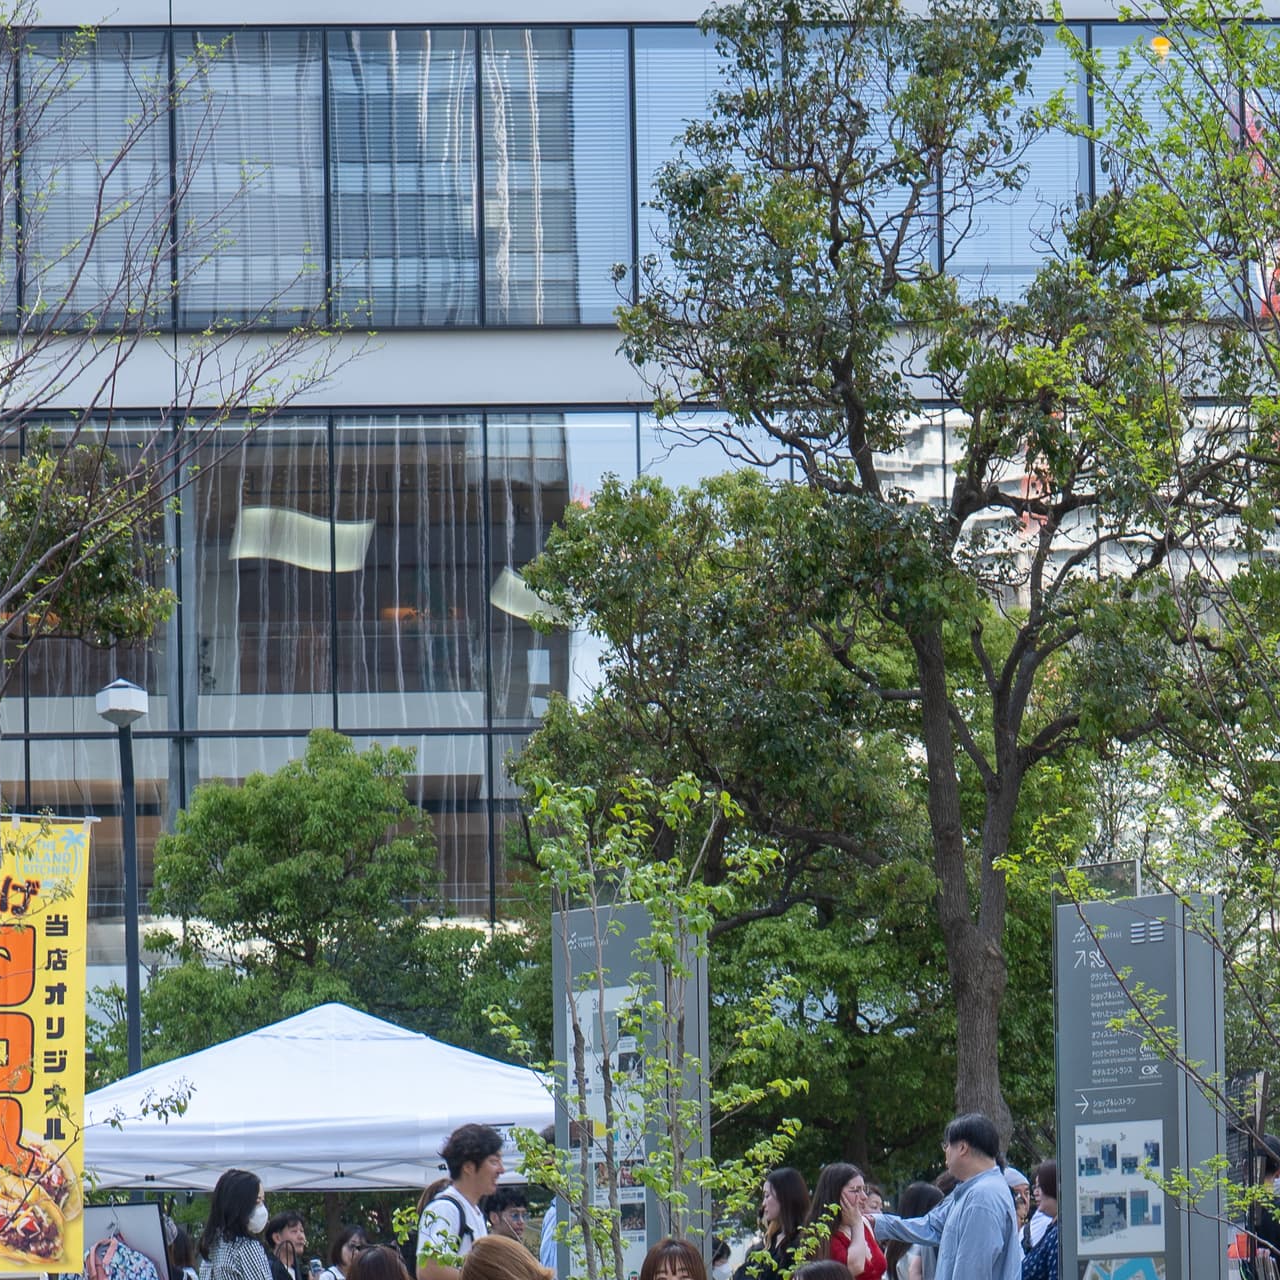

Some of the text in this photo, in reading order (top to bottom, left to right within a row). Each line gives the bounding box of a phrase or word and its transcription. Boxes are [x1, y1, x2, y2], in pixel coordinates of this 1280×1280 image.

[36, 840, 56, 851] THE
[23, 864, 71, 875] KITCHEN
[43, 914, 68, 1141] 当店オリジナル
